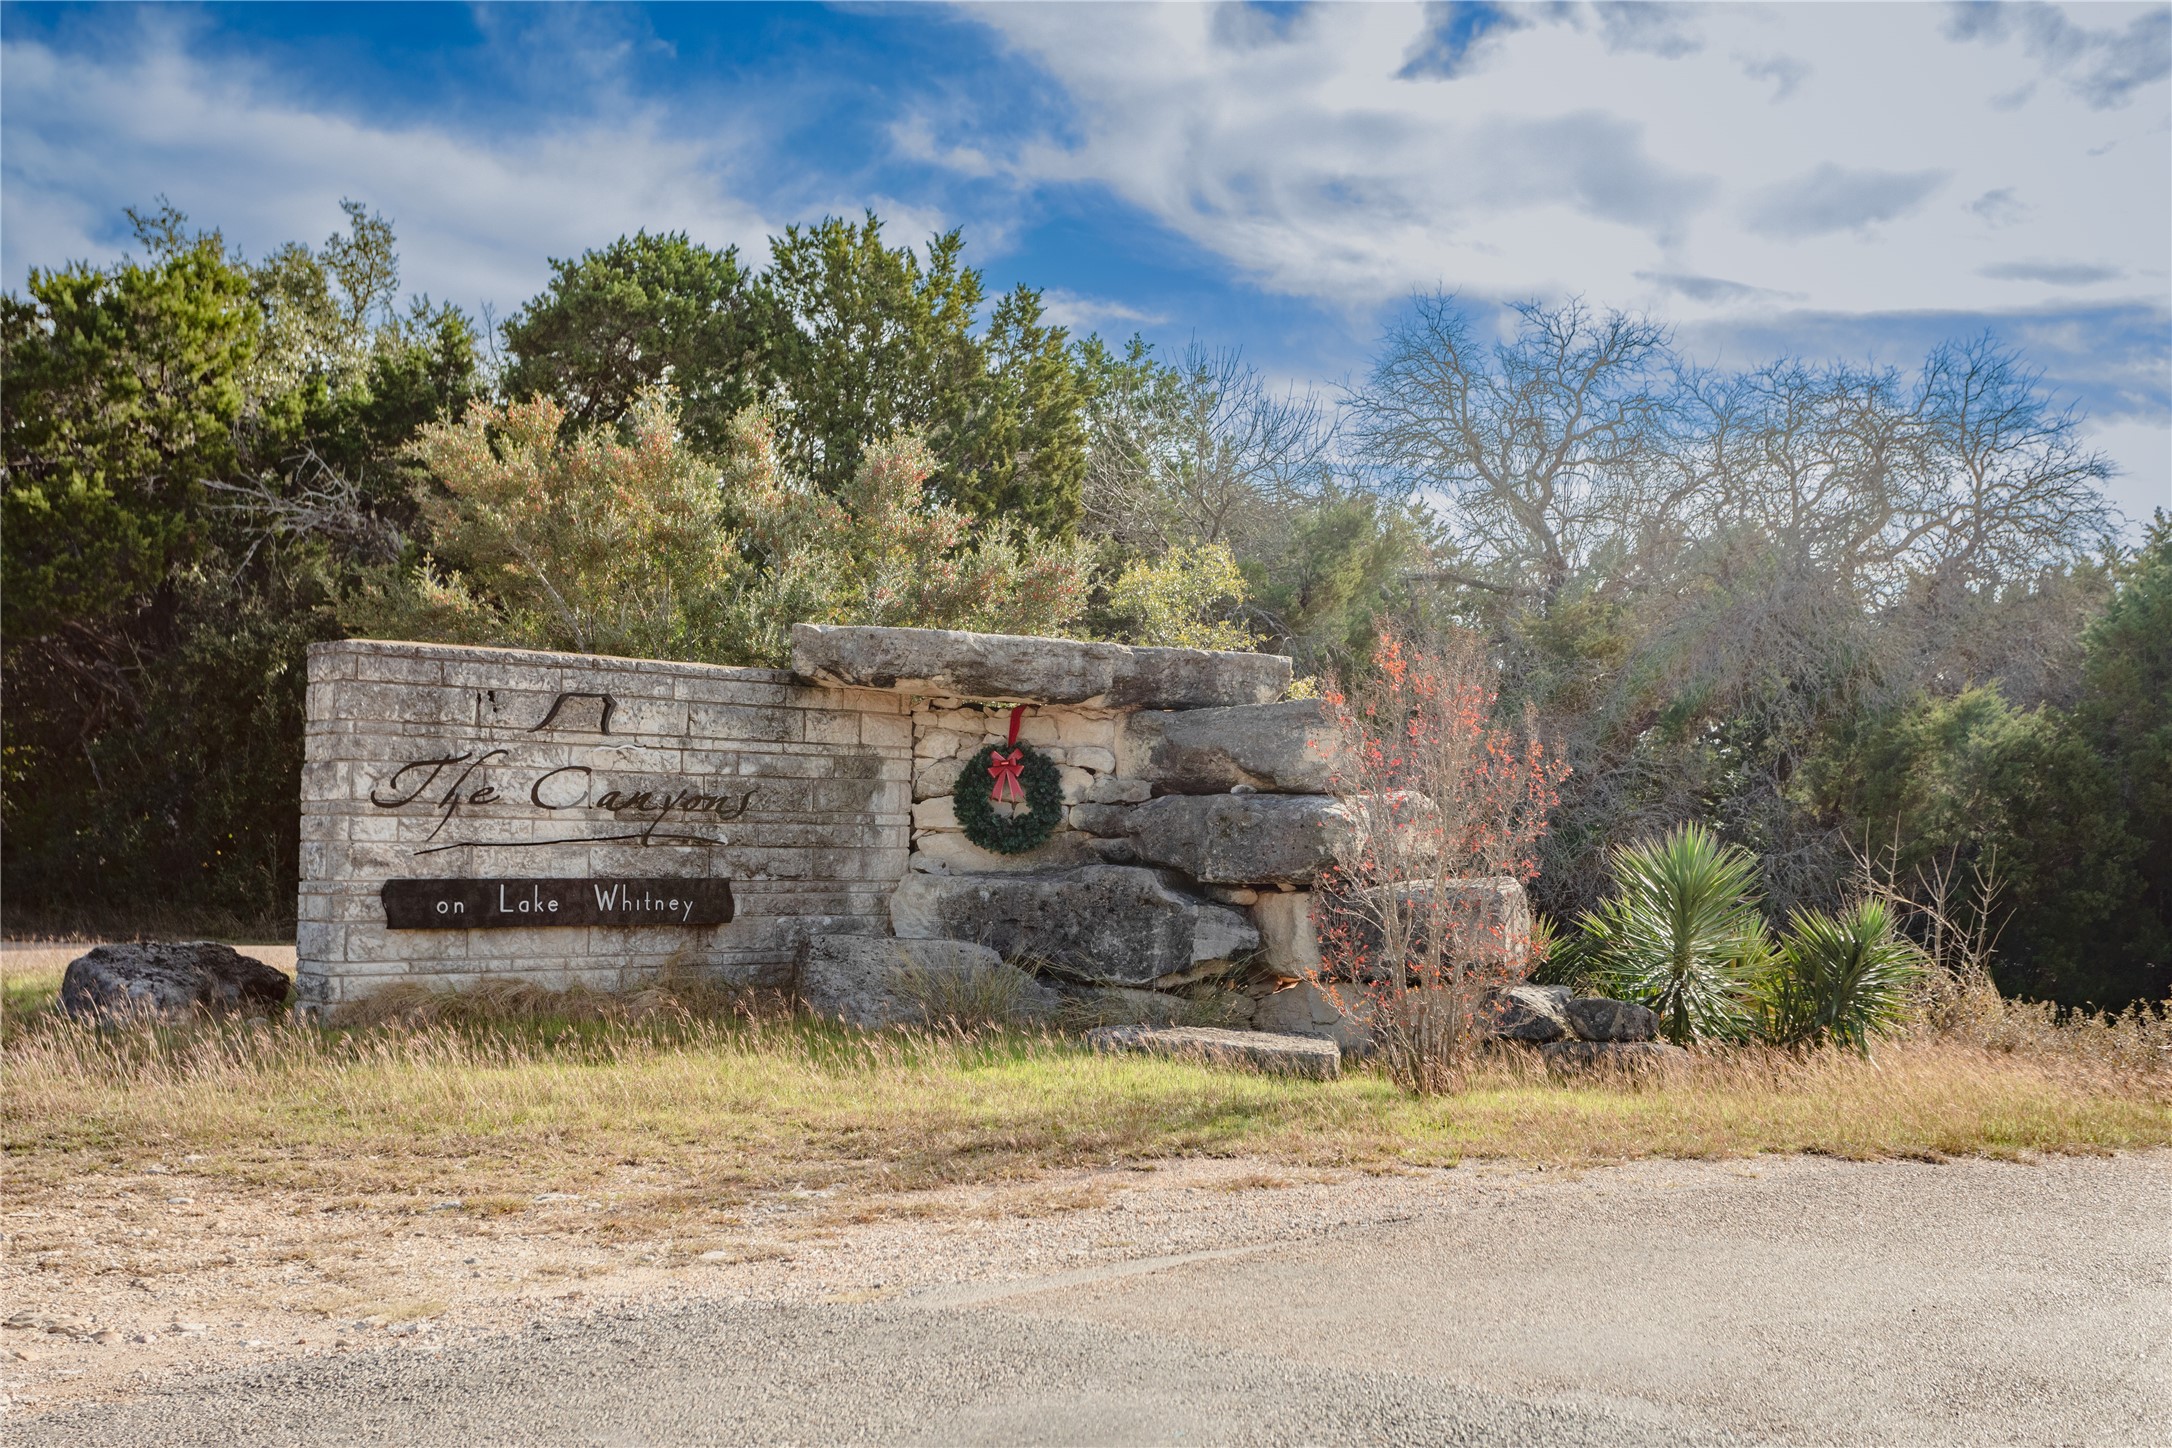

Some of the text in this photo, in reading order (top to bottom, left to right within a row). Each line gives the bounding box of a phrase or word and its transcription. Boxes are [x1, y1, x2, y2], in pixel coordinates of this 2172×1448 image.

[371, 750, 757, 847] The Canyons
[436, 884, 694, 922] on Lake Whitney
